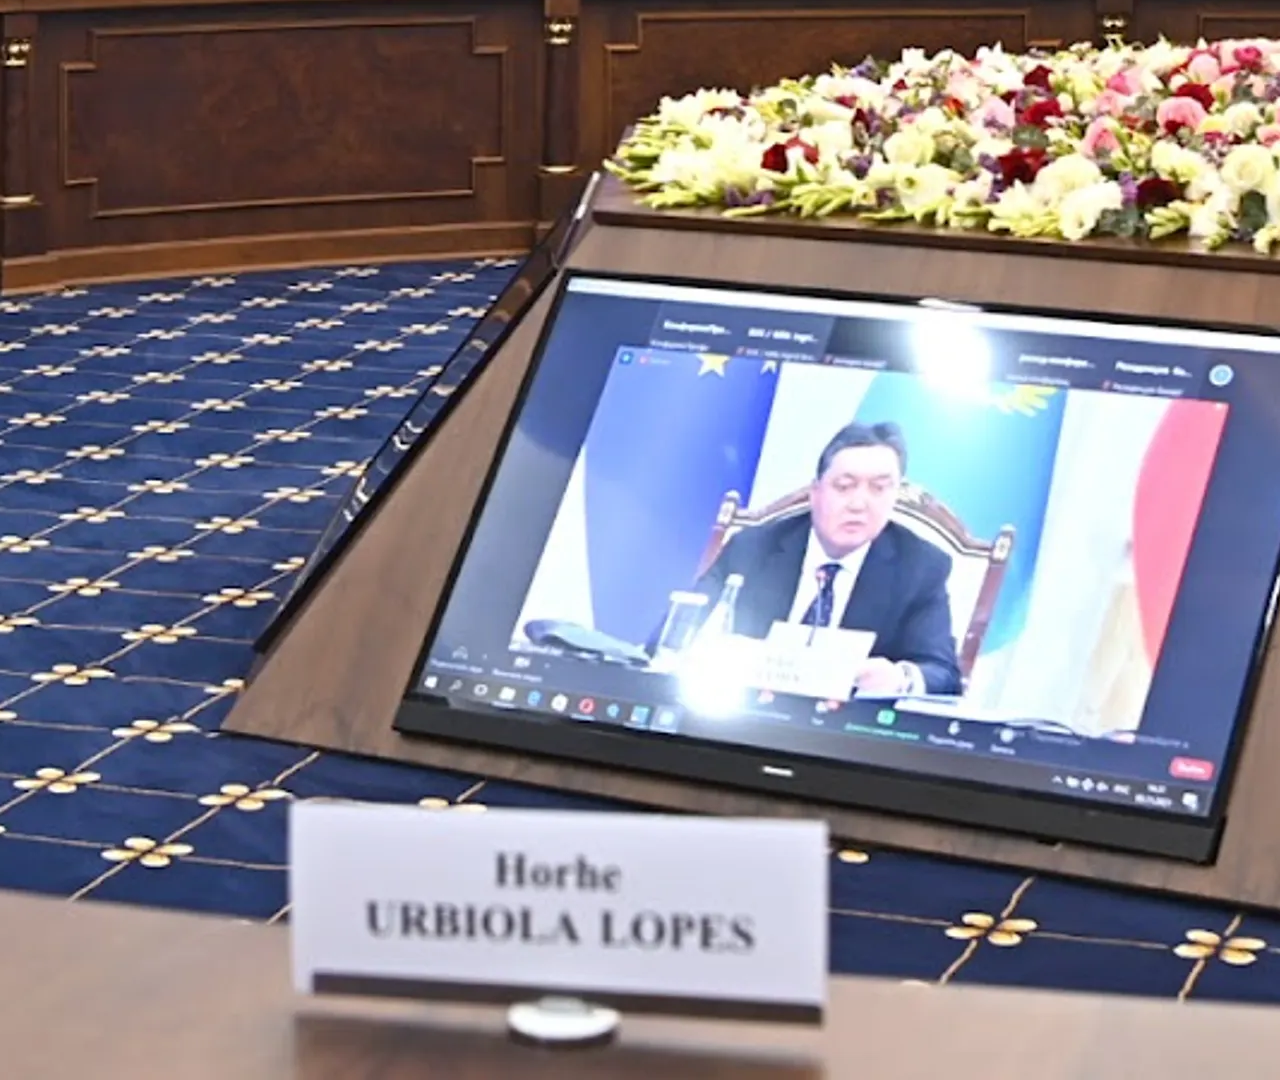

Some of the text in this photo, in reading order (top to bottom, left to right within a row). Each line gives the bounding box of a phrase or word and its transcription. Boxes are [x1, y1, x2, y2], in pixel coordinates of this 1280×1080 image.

[493, 851, 623, 894] Horhe
[364, 899, 757, 955] URBIOLA LOPES
